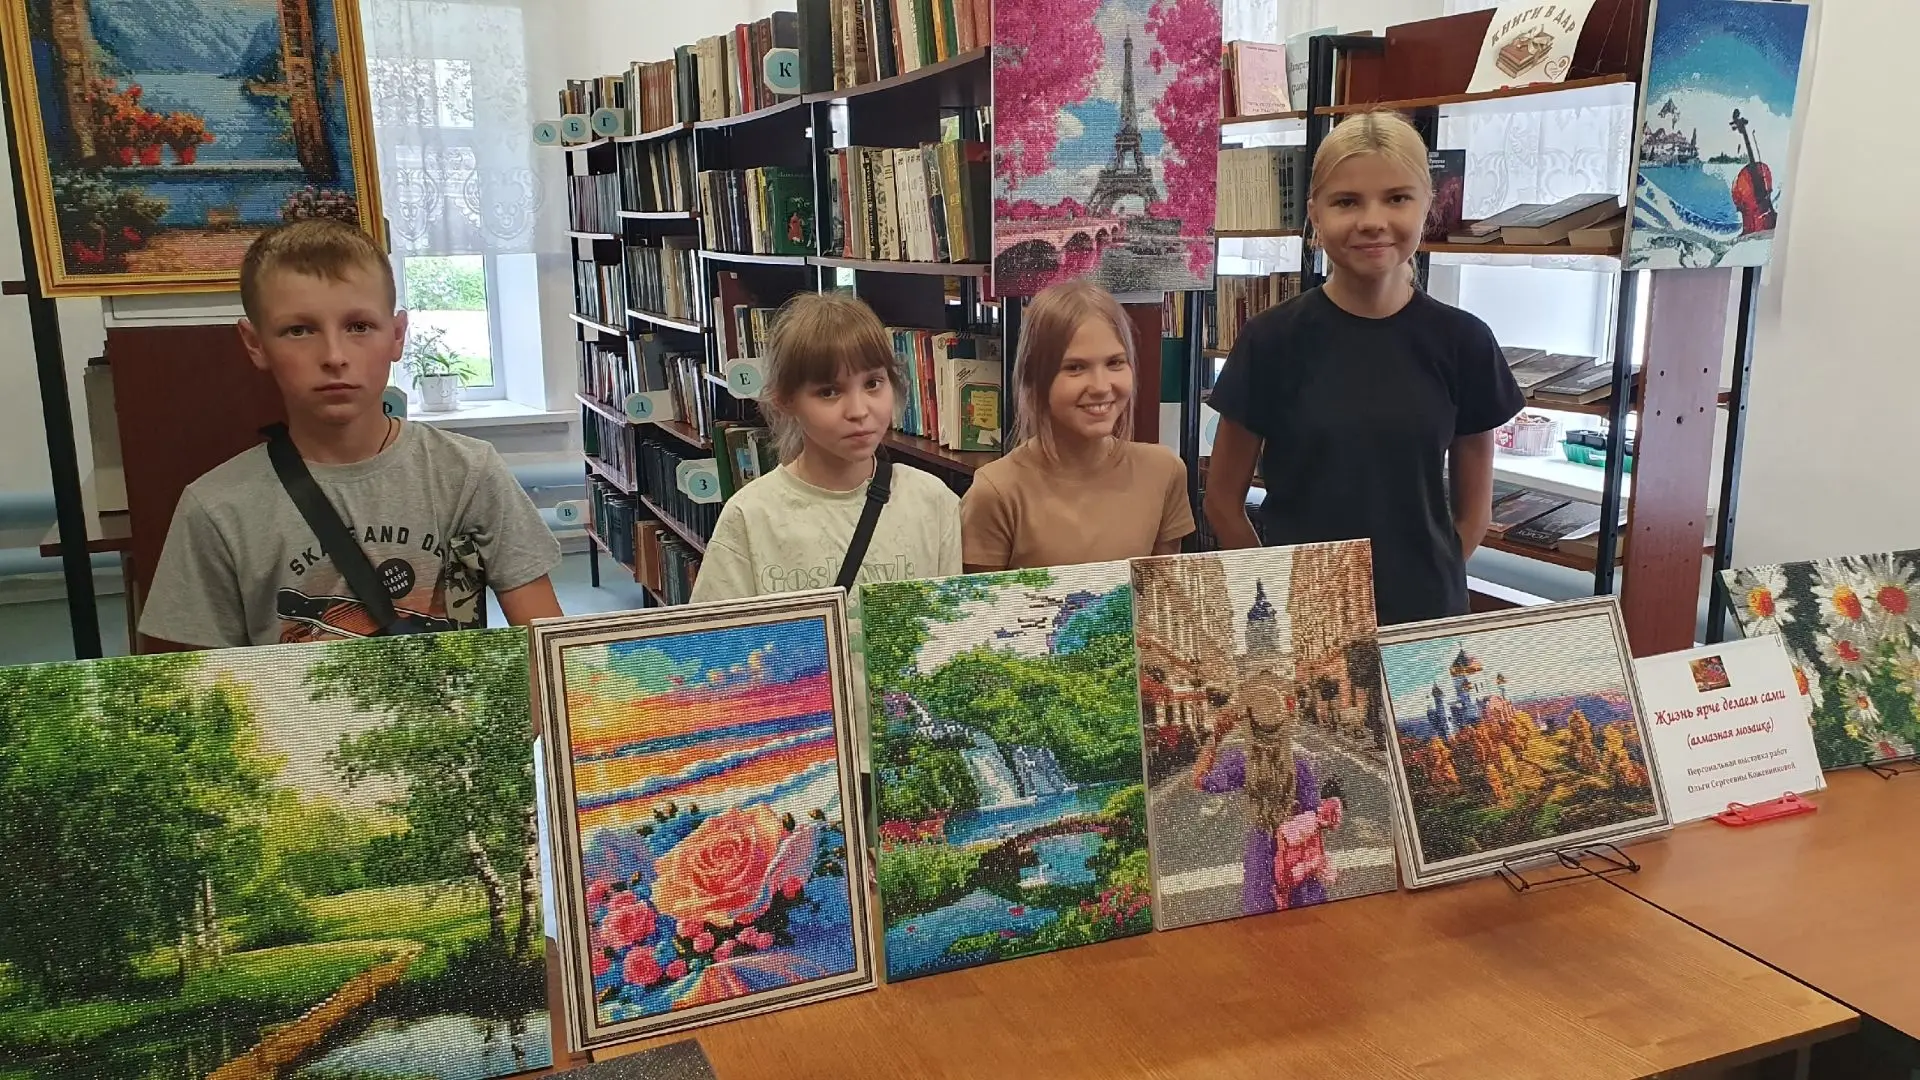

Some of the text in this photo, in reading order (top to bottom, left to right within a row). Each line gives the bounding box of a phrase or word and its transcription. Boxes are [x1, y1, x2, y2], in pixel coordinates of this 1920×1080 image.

[1491, 5, 1576, 47] КНИГИ В ДАР
[779, 62, 792, 78] К
[570, 122, 579, 132] Б
[602, 117, 610, 127] Г
[541, 129, 550, 138] А
[739, 373, 751, 386] Е
[636, 401, 647, 413] Д
[564, 507, 572, 517] В
[364, 525, 410, 545] AND
[383, 570, 408, 587] CLASSIC
[389, 580, 409, 593] BOARD
[1653, 689, 1786, 725] Жизнь ярче делаем сами
[1687, 733, 1734, 750] (алмазная
[1687, 747, 1788, 777] Персональная выставка работ
[1687, 782, 1711, 794] Ольги
[1710, 774, 1748, 788] Сергеевны
